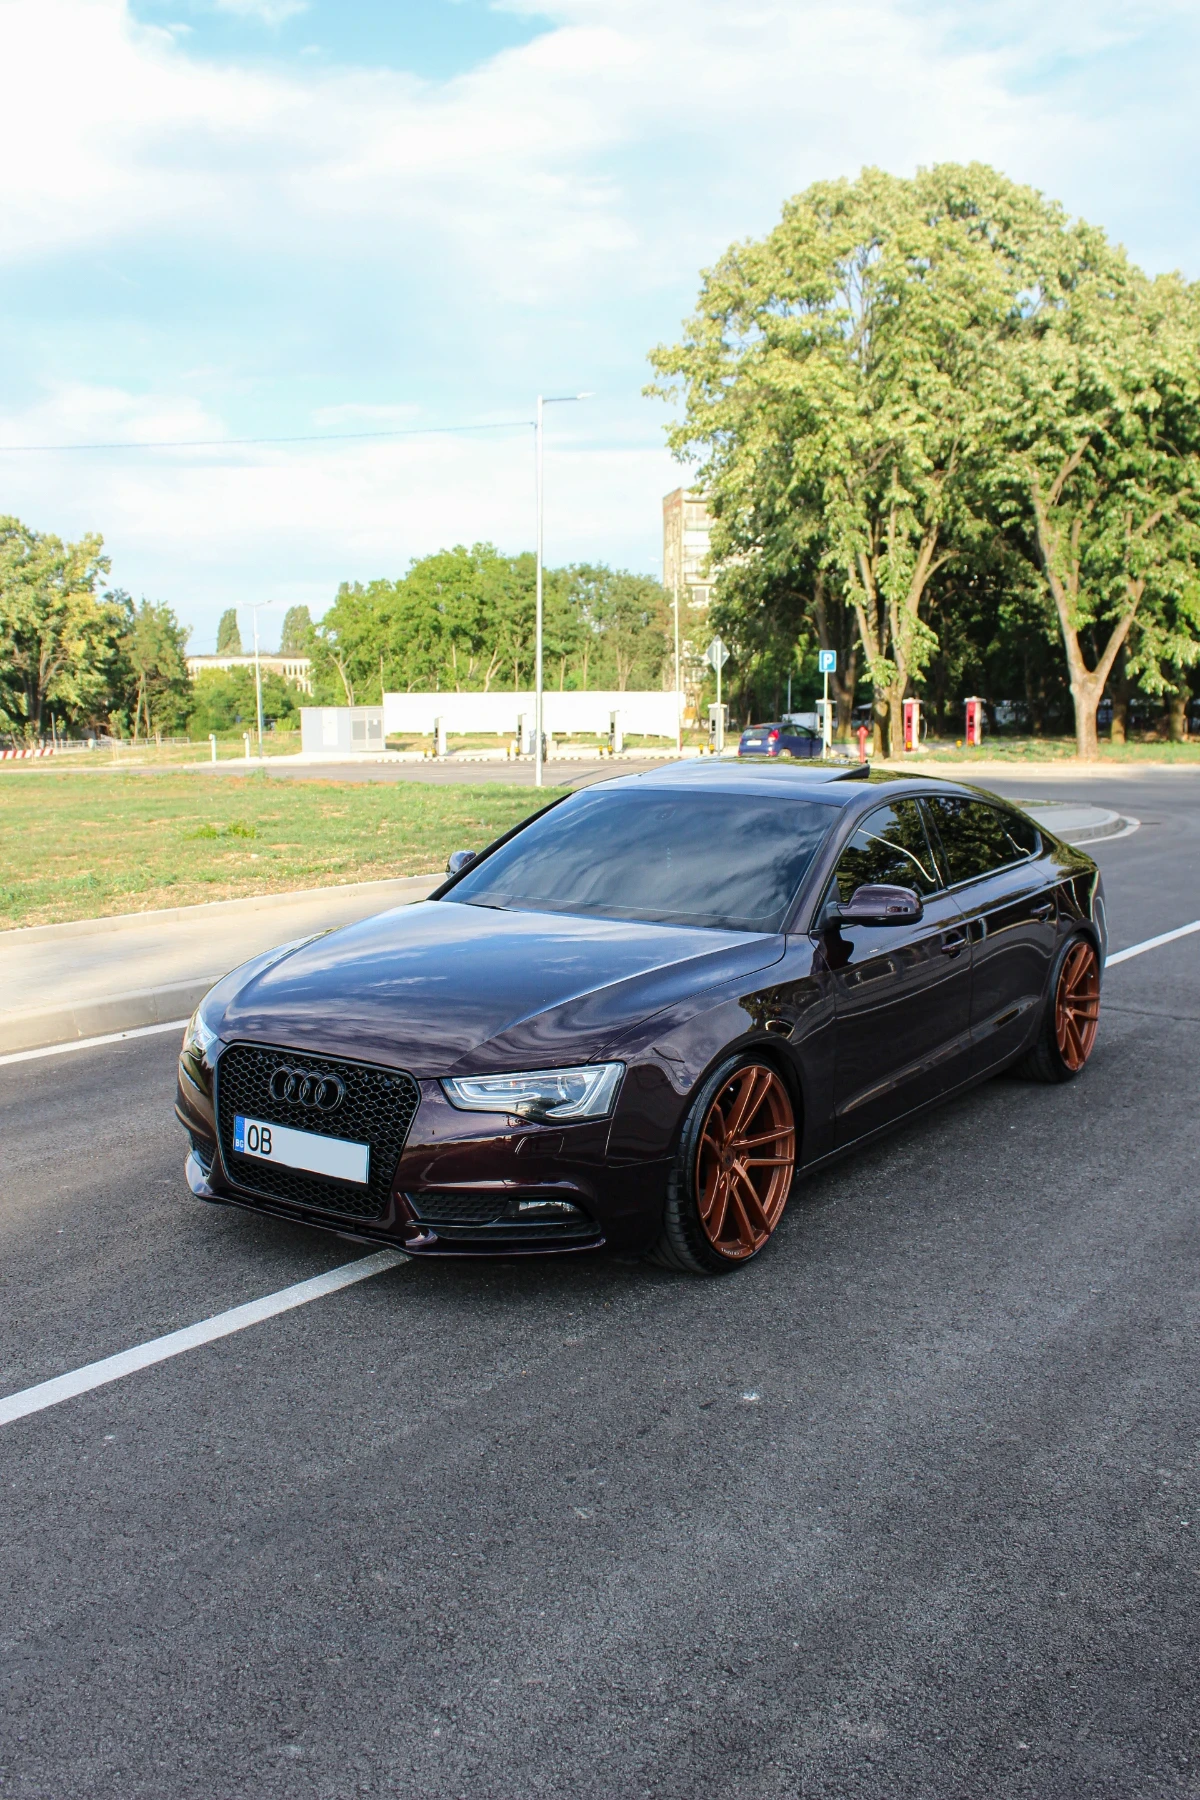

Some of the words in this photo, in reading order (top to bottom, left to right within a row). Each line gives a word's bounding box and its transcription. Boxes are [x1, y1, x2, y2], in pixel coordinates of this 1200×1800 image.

[823, 653, 833, 670] P
[235, 1138, 244, 1148] BG
[247, 1124, 272, 1155] OB
